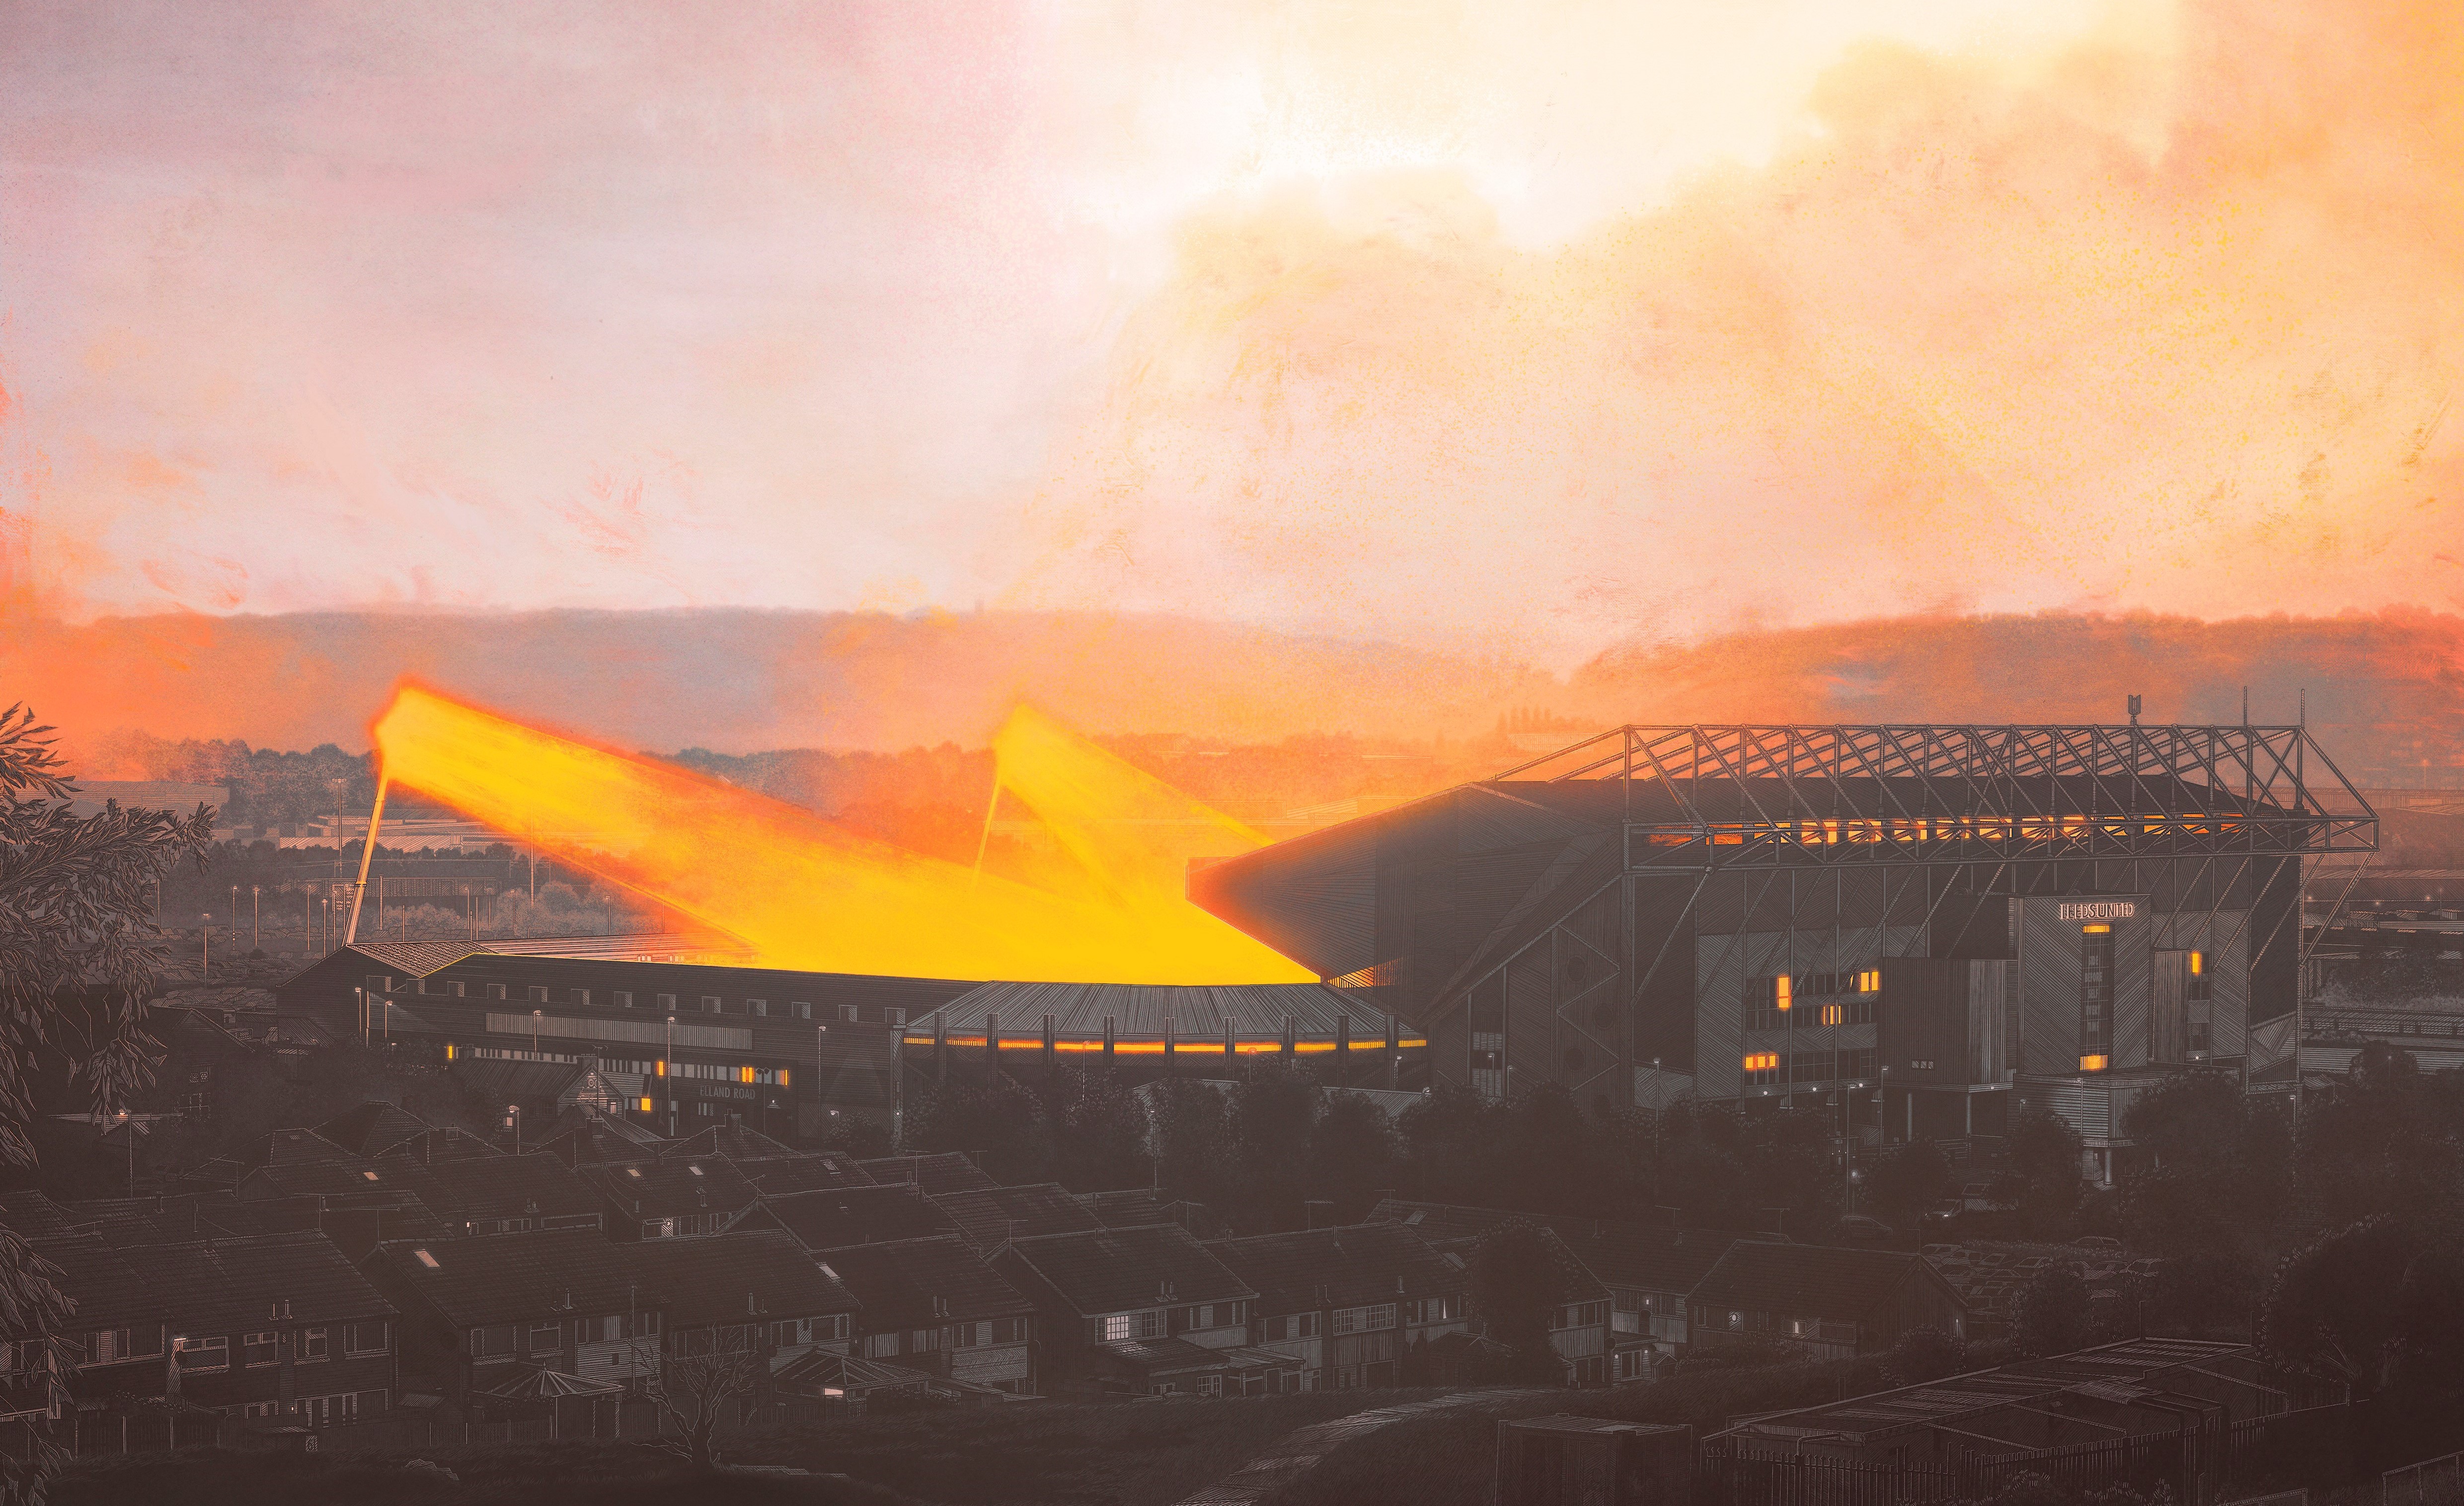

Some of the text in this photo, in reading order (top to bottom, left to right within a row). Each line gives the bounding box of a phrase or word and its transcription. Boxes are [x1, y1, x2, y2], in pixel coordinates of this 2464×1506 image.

[2084, 972, 2102, 982] BEFORE
[700, 1085, 756, 1099] ELLAND ROAD
